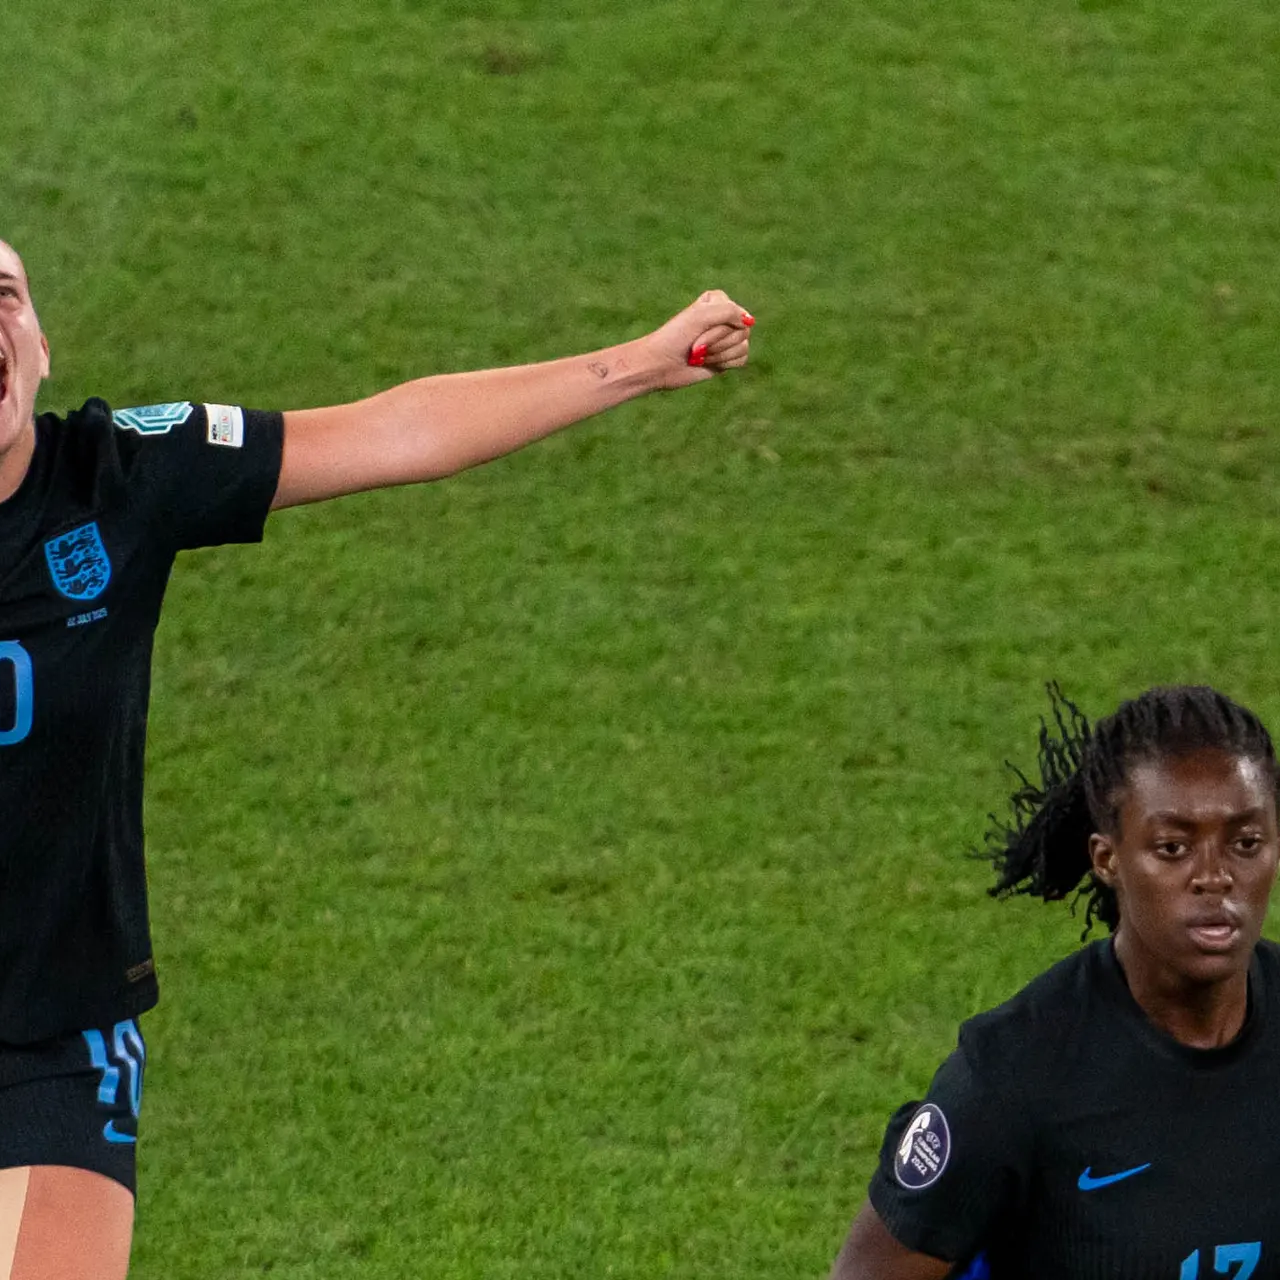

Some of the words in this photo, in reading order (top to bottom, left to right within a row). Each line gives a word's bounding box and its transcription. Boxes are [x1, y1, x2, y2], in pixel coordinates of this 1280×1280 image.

[81, 1018, 145, 1119] 10
[913, 1141, 938, 1172] CHAMPIONS
[917, 1136, 941, 1164] EUROPEAN
[911, 1155, 928, 1176] 2022
